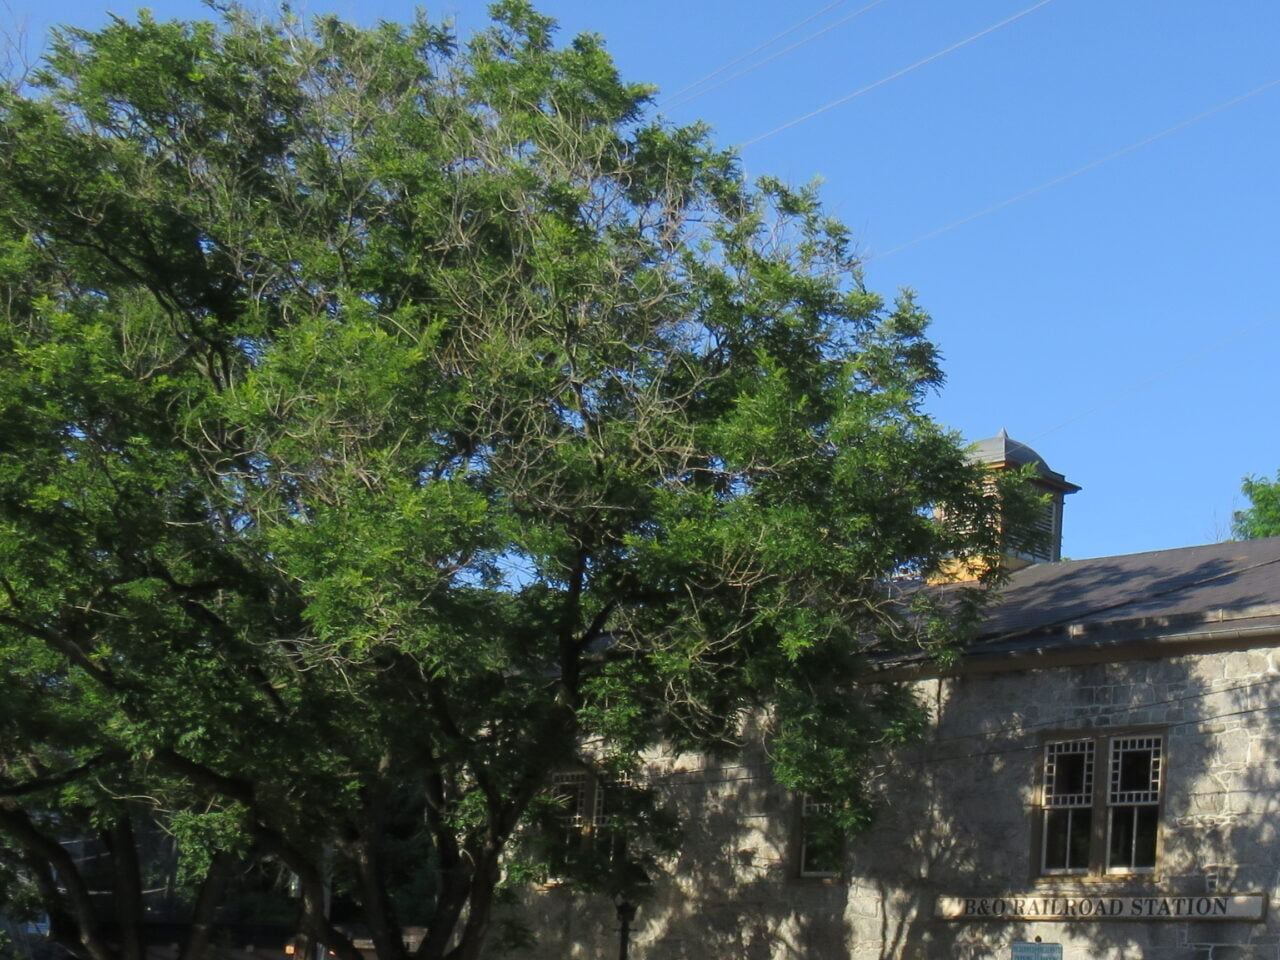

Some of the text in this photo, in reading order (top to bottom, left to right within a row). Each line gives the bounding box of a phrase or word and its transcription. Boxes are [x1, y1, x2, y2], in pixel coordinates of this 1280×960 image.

[964, 896, 1229, 916] B&O RAILROAD STATION
